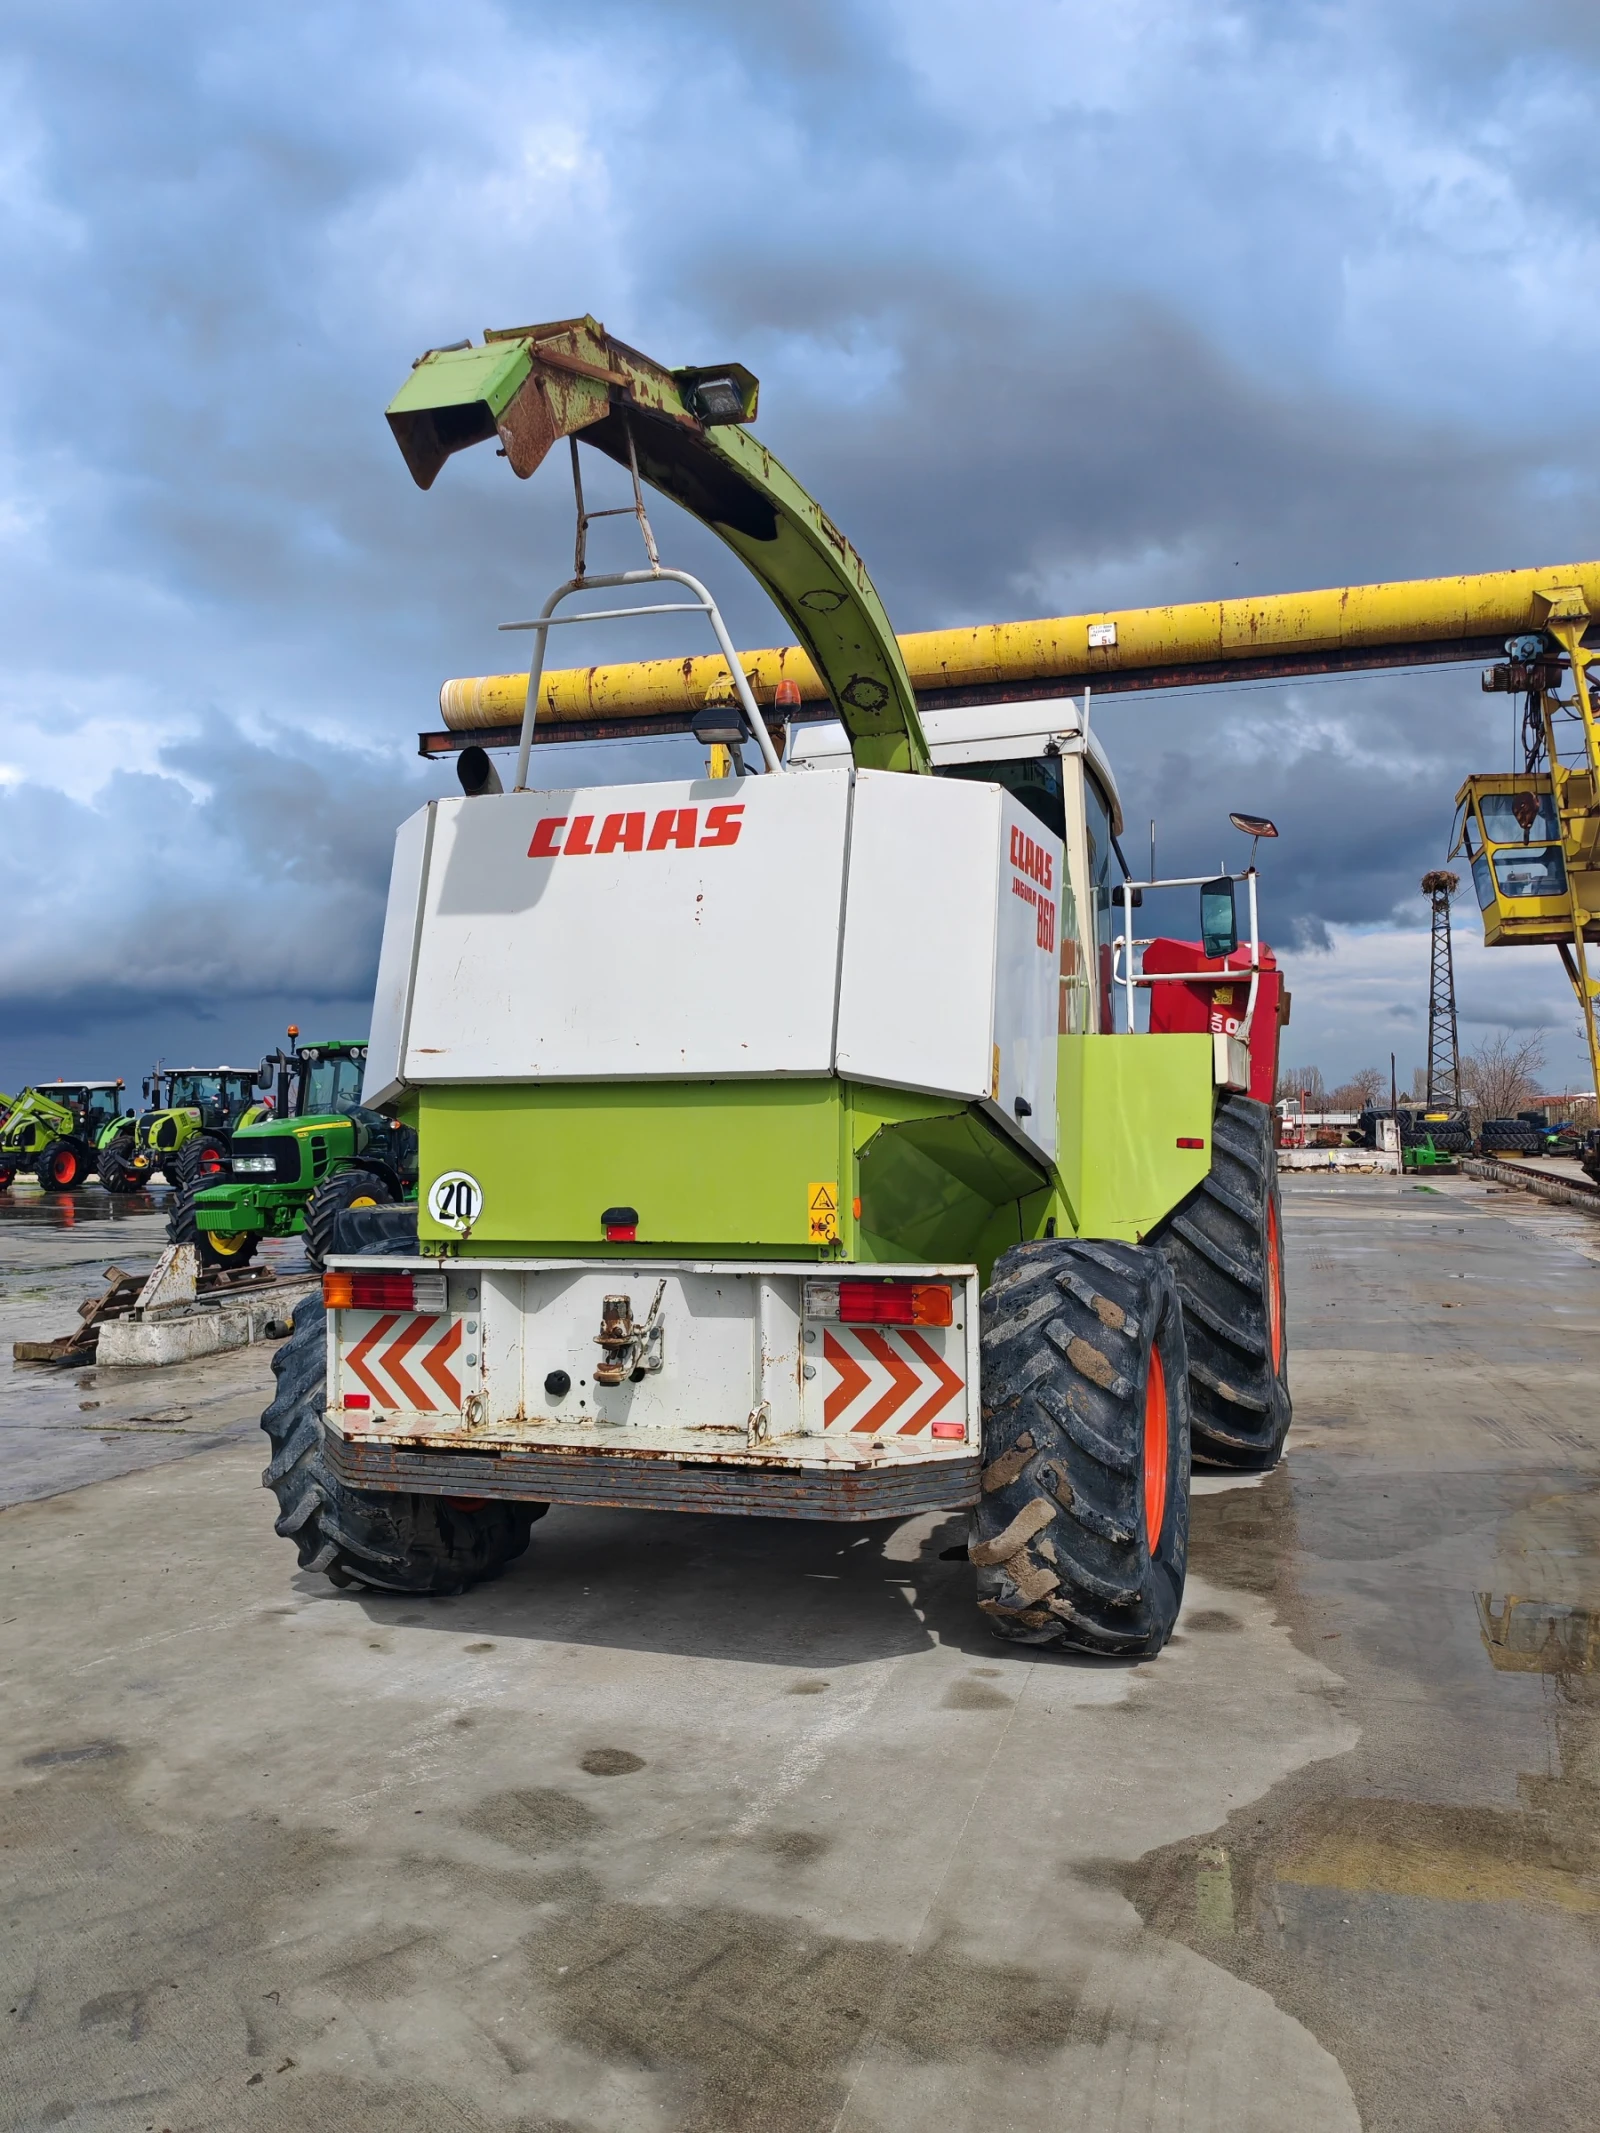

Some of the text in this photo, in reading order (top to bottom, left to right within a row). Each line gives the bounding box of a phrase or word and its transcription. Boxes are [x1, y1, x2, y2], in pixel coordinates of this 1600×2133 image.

[527, 804, 746, 858] CLAAS
[1010, 824, 1053, 891] CLAAS
[1036, 893, 1055, 954] 860
[438, 1181, 472, 1220] 20
